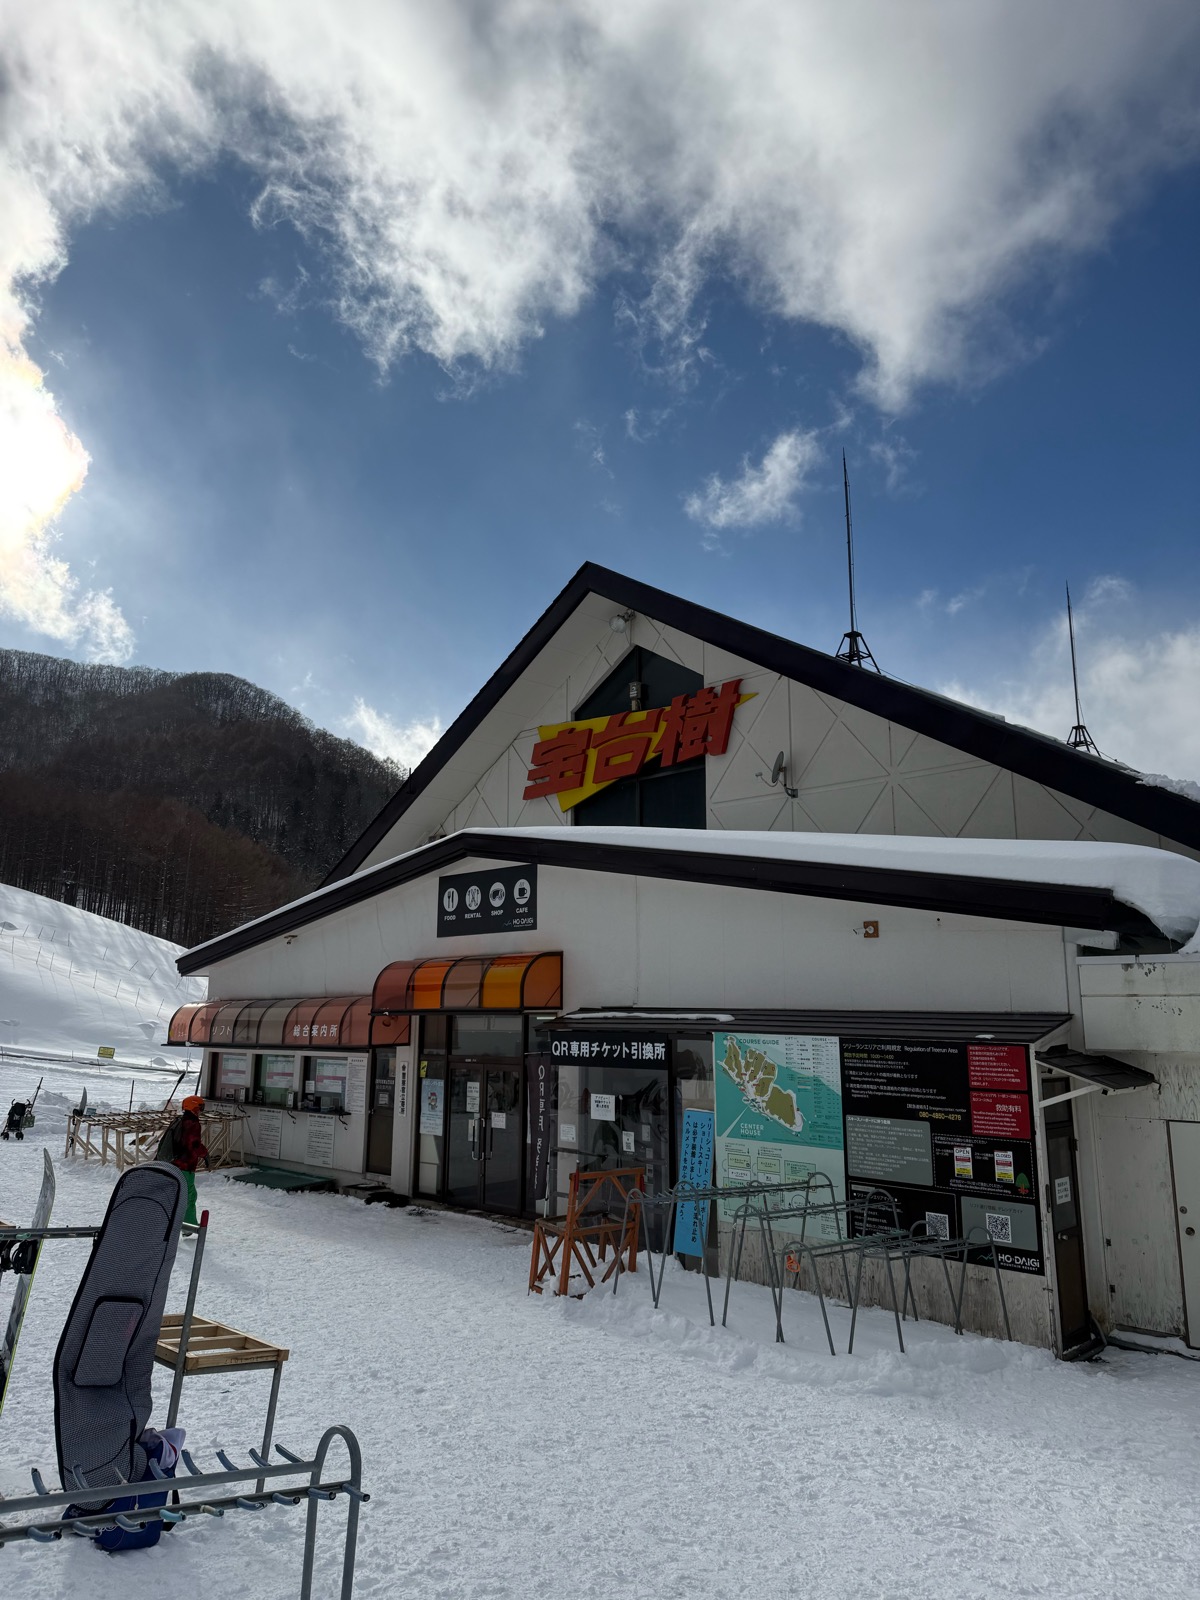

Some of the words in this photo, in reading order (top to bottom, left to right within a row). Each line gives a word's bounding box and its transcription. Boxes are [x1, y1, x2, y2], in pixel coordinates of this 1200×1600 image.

[523, 678, 744, 801] 宝台樹
[516, 906, 528, 914] CAFE
[212, 1026, 232, 1035] リフト
[293, 1024, 338, 1038] 総合案内所
[552, 1041, 666, 1060] QR専用チケット引換所
[740, 1122, 764, 1131] CENTER
[740, 1128, 761, 1136] HOUSE
